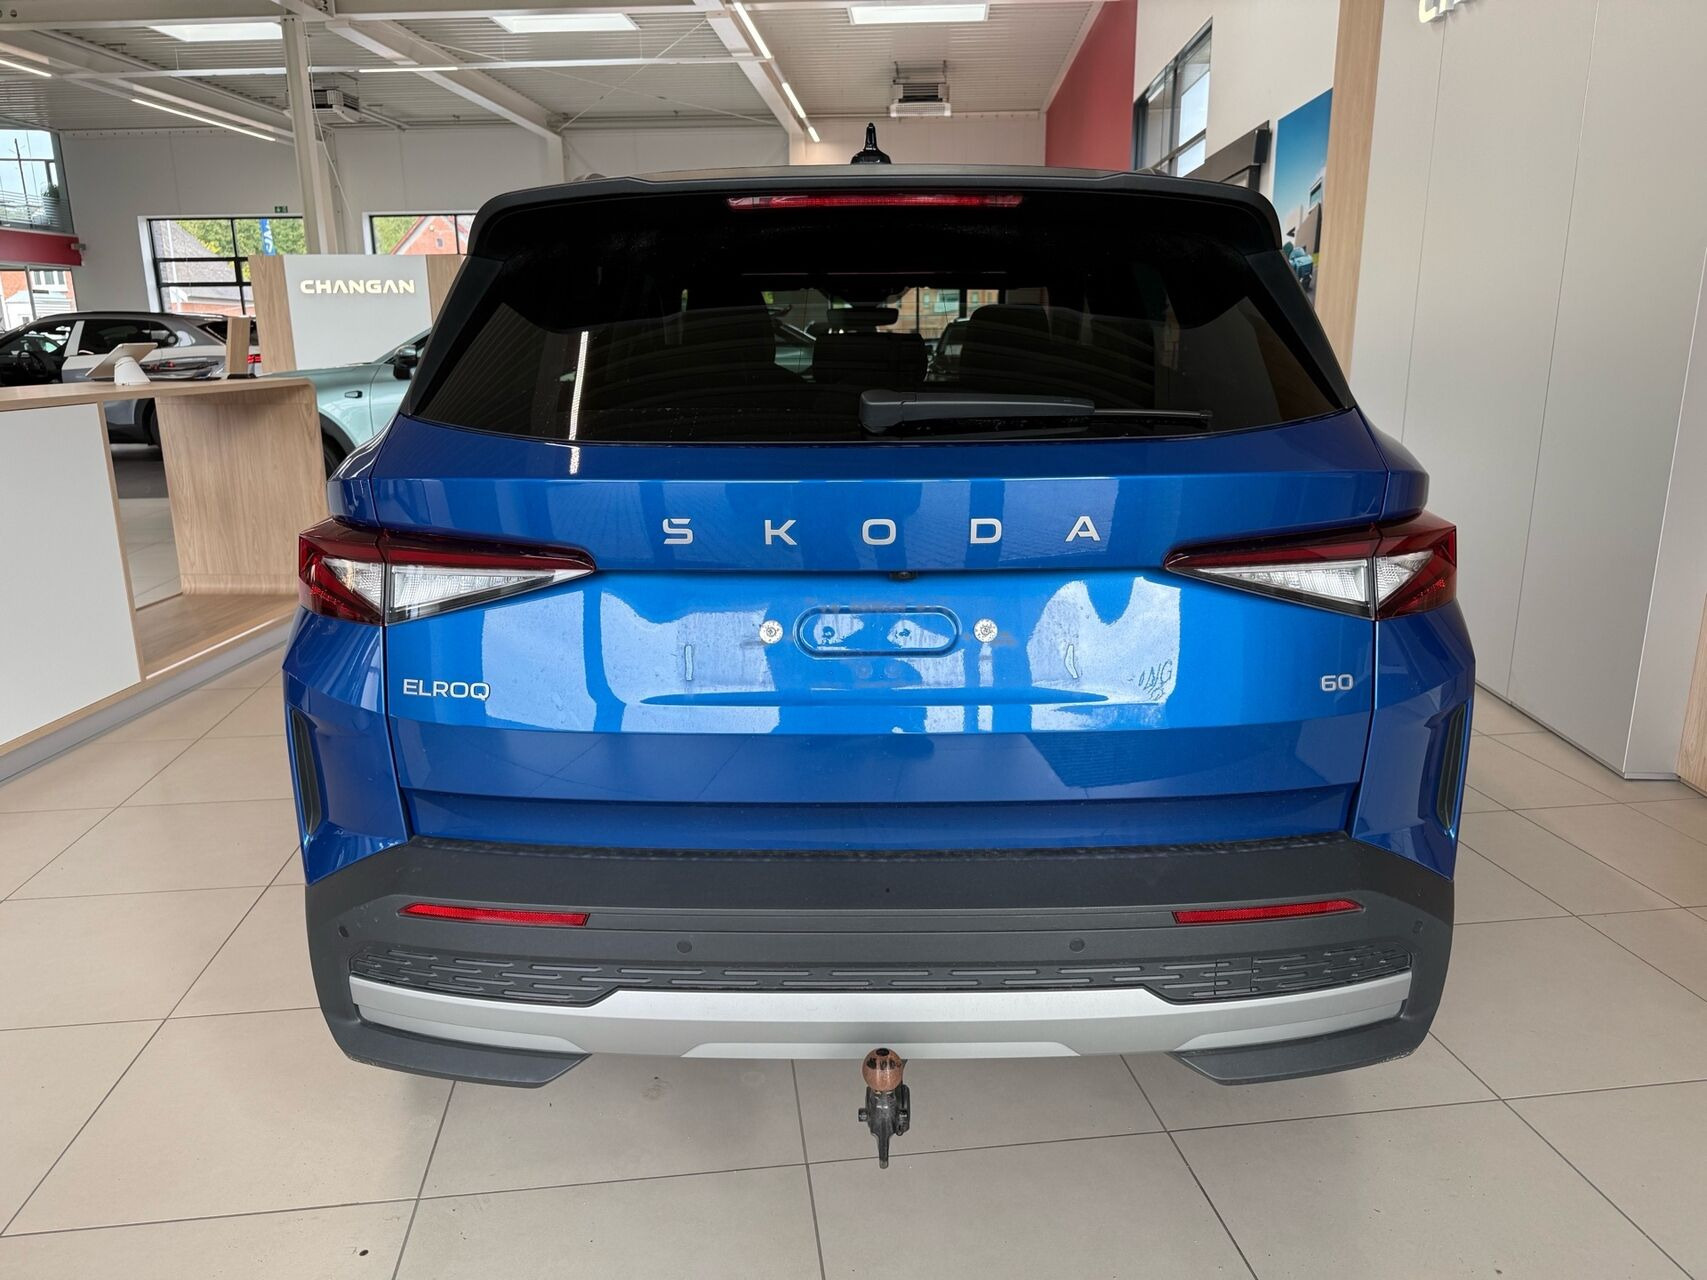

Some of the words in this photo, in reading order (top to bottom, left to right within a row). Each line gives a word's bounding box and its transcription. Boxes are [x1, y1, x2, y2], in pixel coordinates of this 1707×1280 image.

[300, 279, 415, 294] CHANGAN
[662, 515, 1101, 546] SKODA
[403, 678, 491, 701] ELROQ
[1321, 674, 1353, 691] 60
